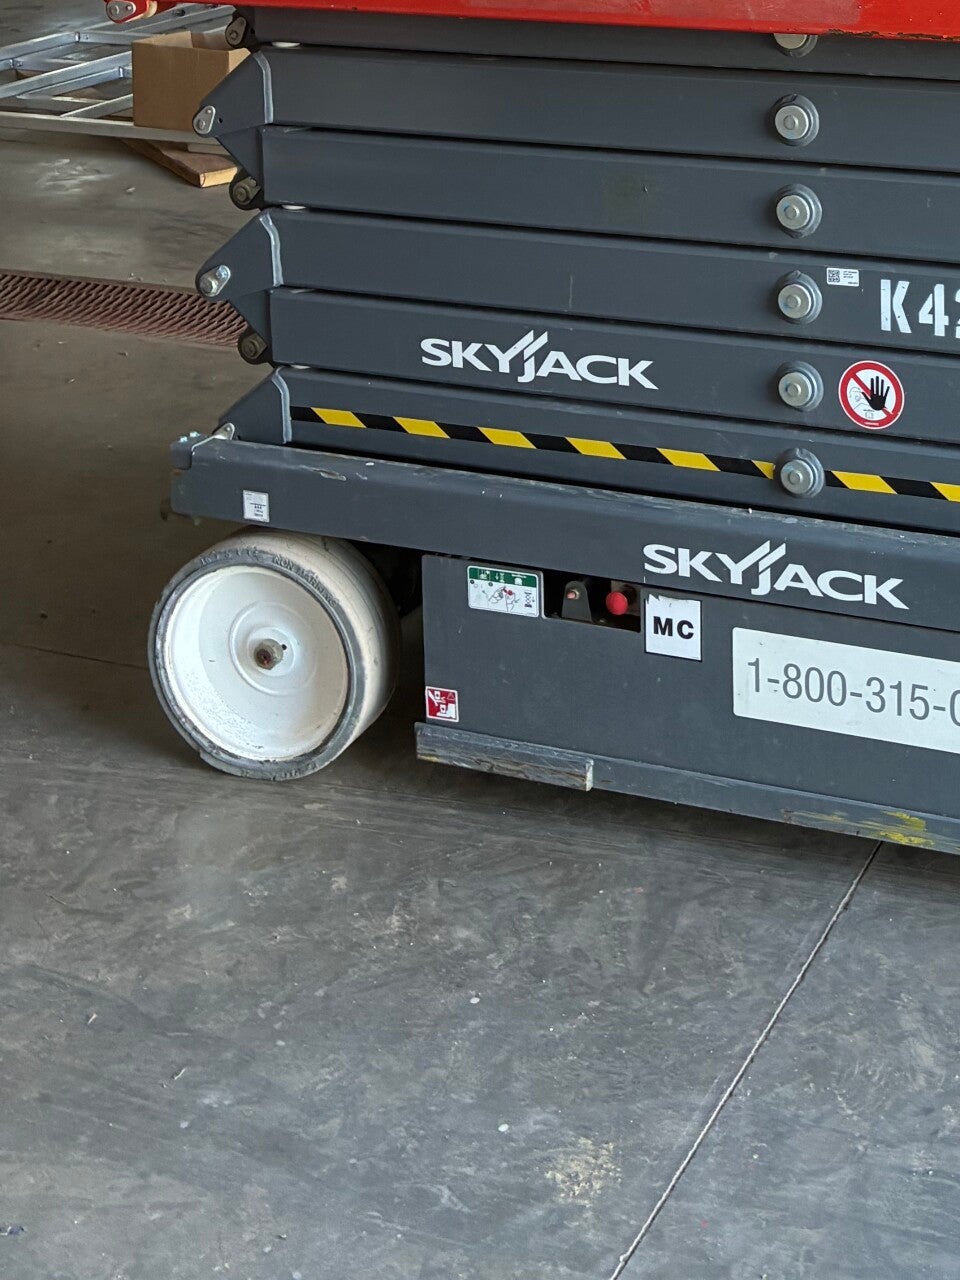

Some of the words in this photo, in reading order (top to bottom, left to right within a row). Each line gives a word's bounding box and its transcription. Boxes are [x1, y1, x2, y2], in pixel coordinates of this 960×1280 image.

[420, 329, 659, 390] SKYJACK
[642, 539, 909, 610] SKYJACK
[652, 616, 695, 640] MC
